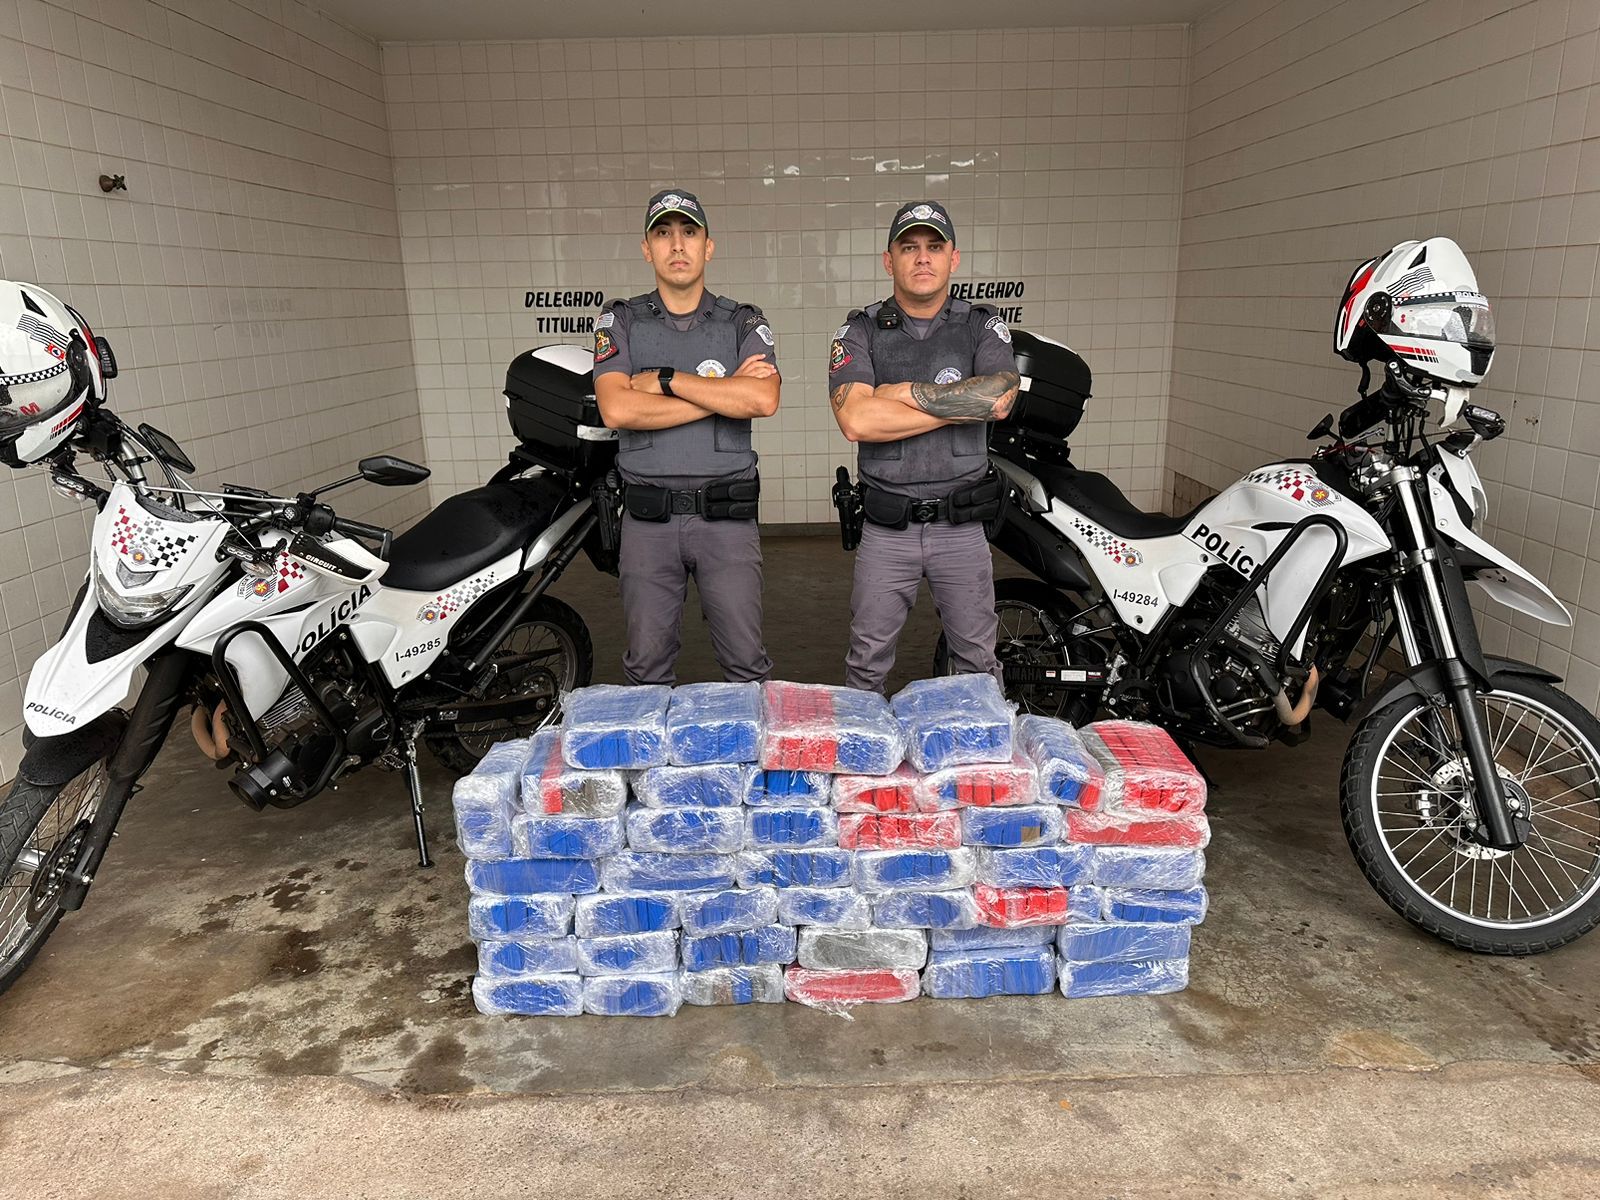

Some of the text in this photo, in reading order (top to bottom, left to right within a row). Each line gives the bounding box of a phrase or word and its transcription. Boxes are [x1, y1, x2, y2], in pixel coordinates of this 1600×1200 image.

[524, 291, 604, 308] DELEGADO
[949, 281, 1025, 300] DELEGADO
[536, 317, 595, 334] TITULAR
[1191, 523, 1263, 579] POLÍCI
[305, 554, 337, 571] CIRCUIT
[1113, 589, 1159, 608] I-49284
[395, 637, 441, 662] I-49285
[25, 702, 77, 725] POLÍCIA
